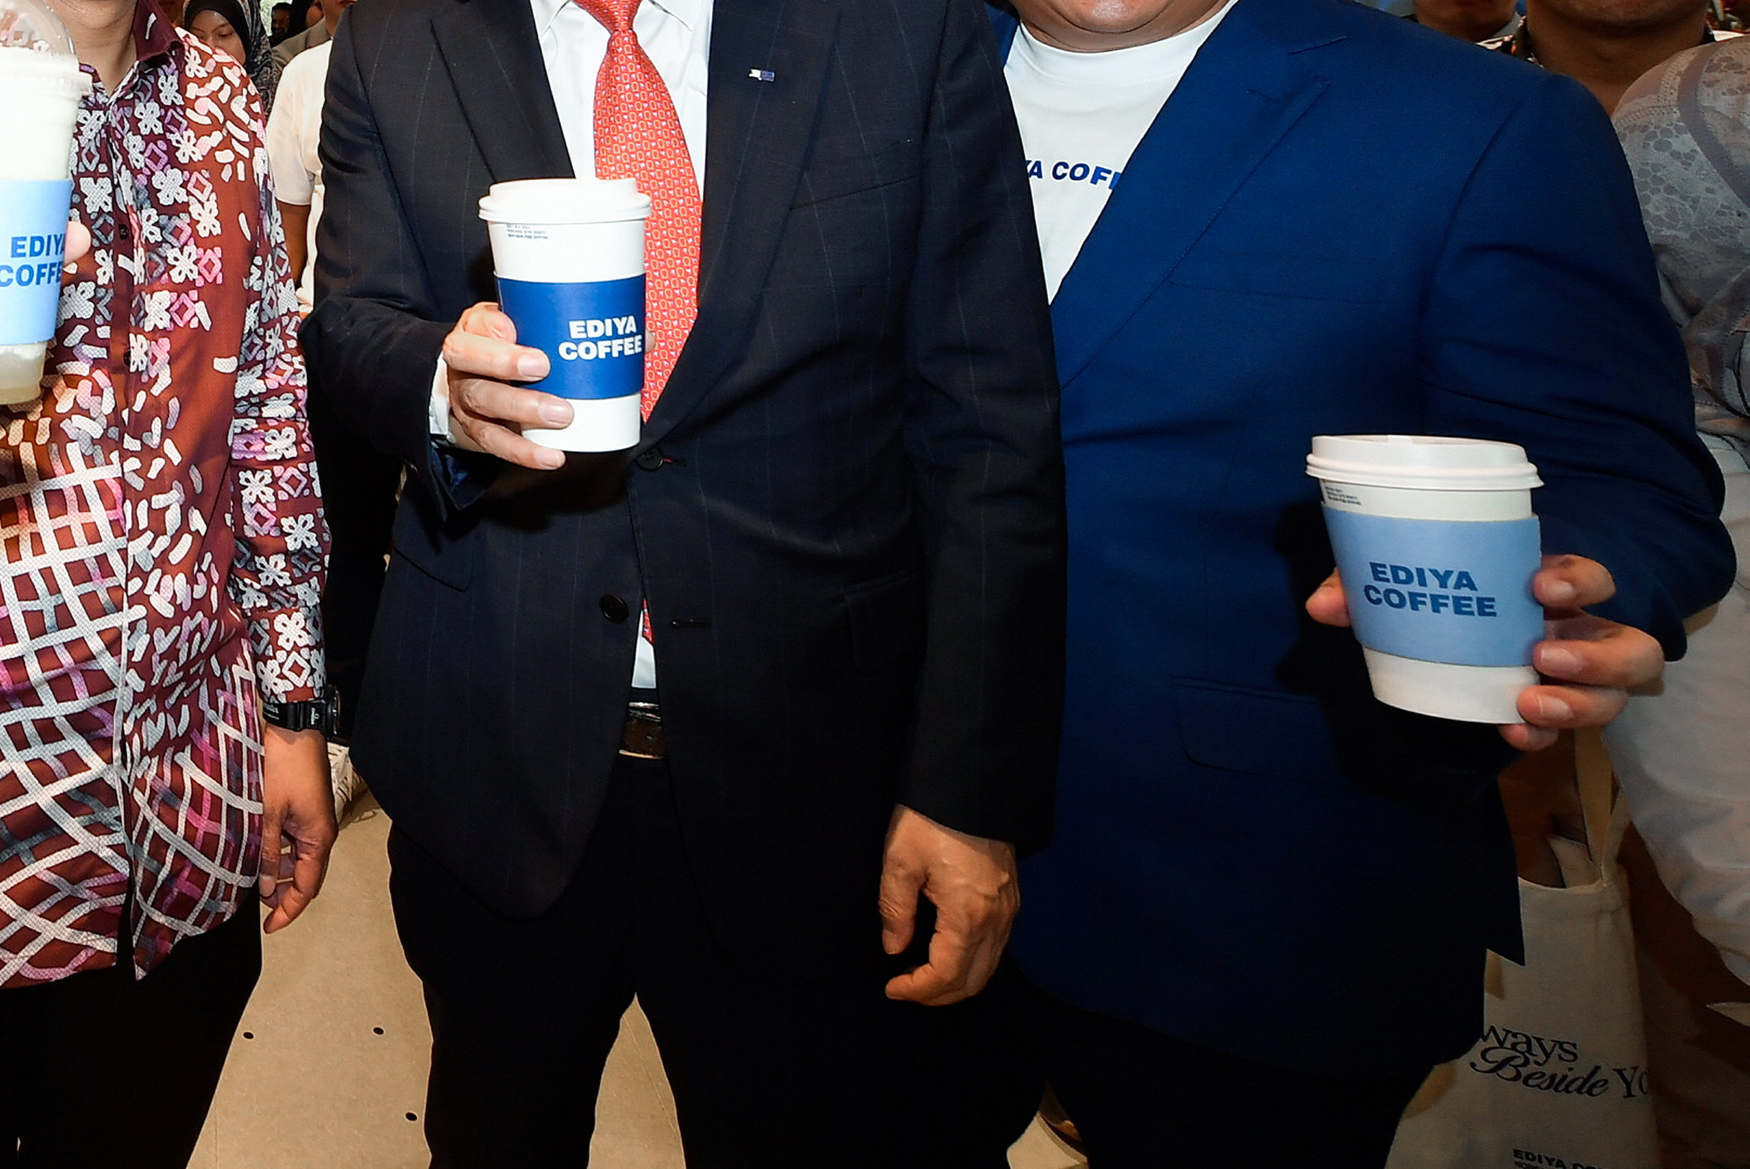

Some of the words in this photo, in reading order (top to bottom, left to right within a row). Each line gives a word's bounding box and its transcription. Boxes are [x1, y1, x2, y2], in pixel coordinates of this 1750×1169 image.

[569, 315, 637, 339] EDIYA
[558, 334, 643, 360] COFFEE
[1369, 561, 1478, 591] EDIYA
[1364, 584, 1497, 617] COFFEE
[1480, 1025, 1578, 1066] ways
[1469, 1045, 1609, 1097] Beside
